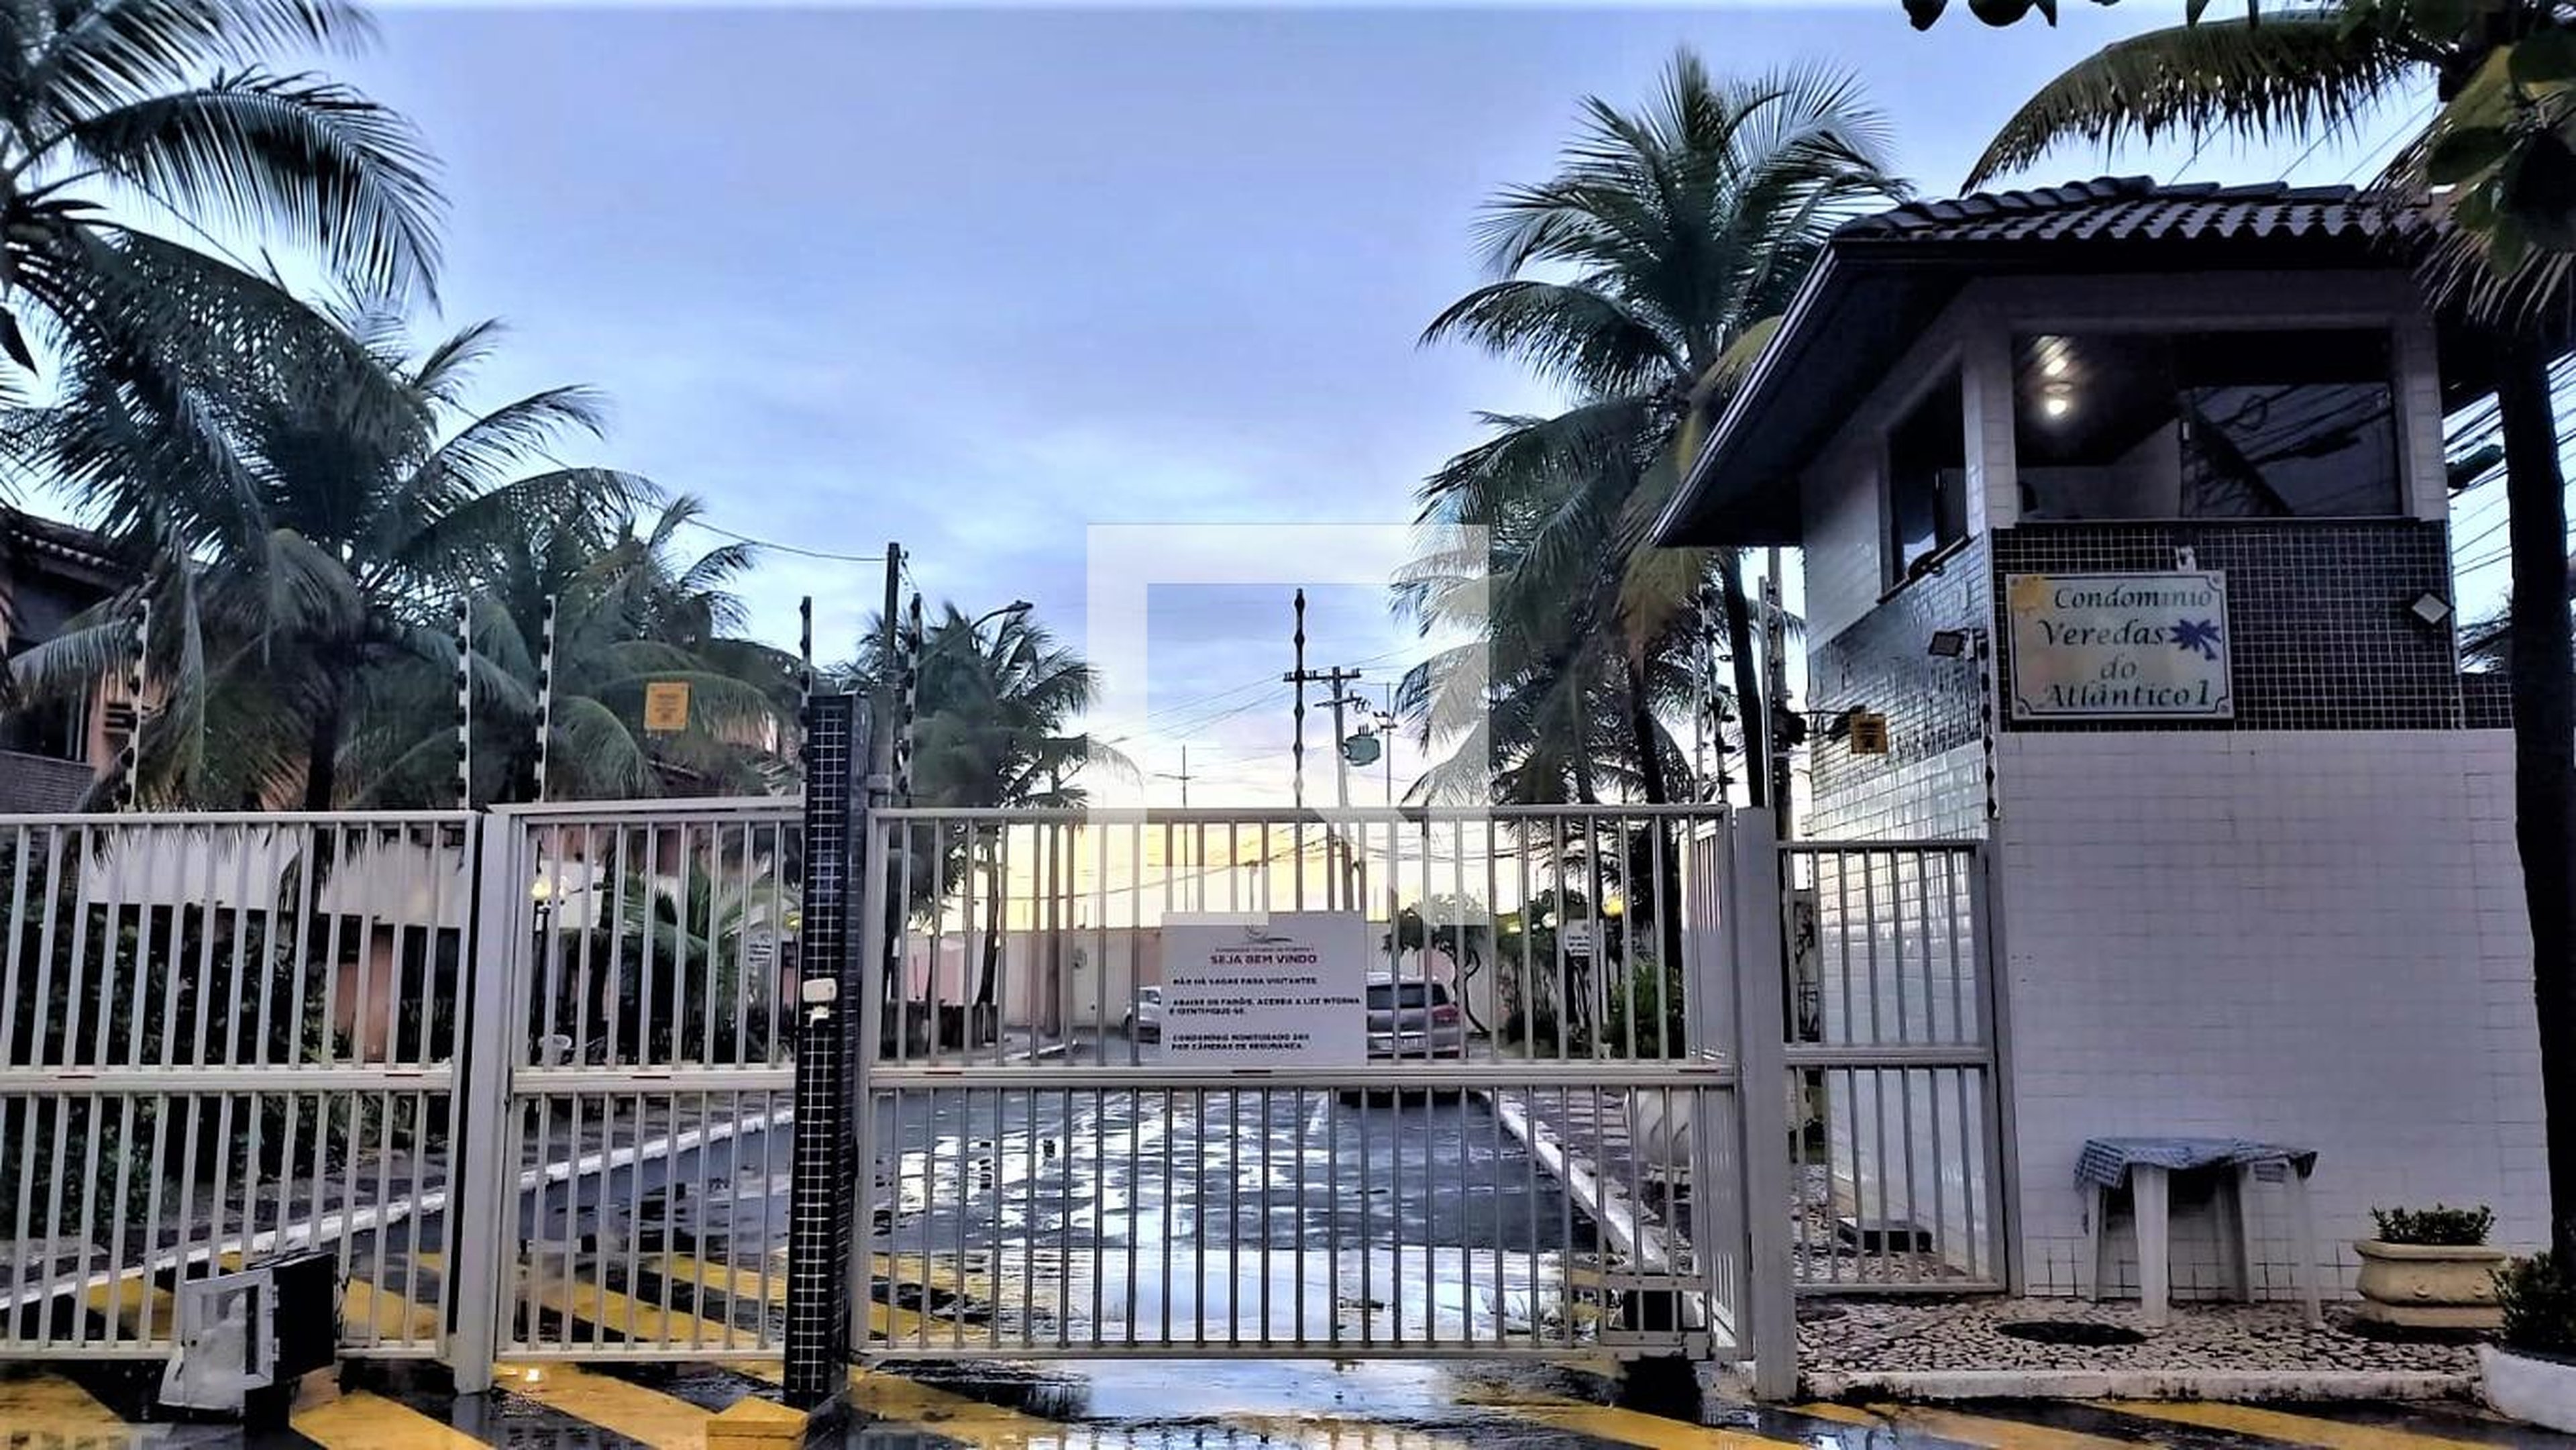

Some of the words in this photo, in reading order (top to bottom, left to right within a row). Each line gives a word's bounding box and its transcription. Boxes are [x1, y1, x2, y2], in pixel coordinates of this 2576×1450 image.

[2037, 619, 2167, 645] Veredas
[2100, 654, 2137, 680] do
[1210, 954, 1242, 964] SEJA
[1245, 954, 1273, 964] BEM
[1277, 954, 1317, 964] VINDO
